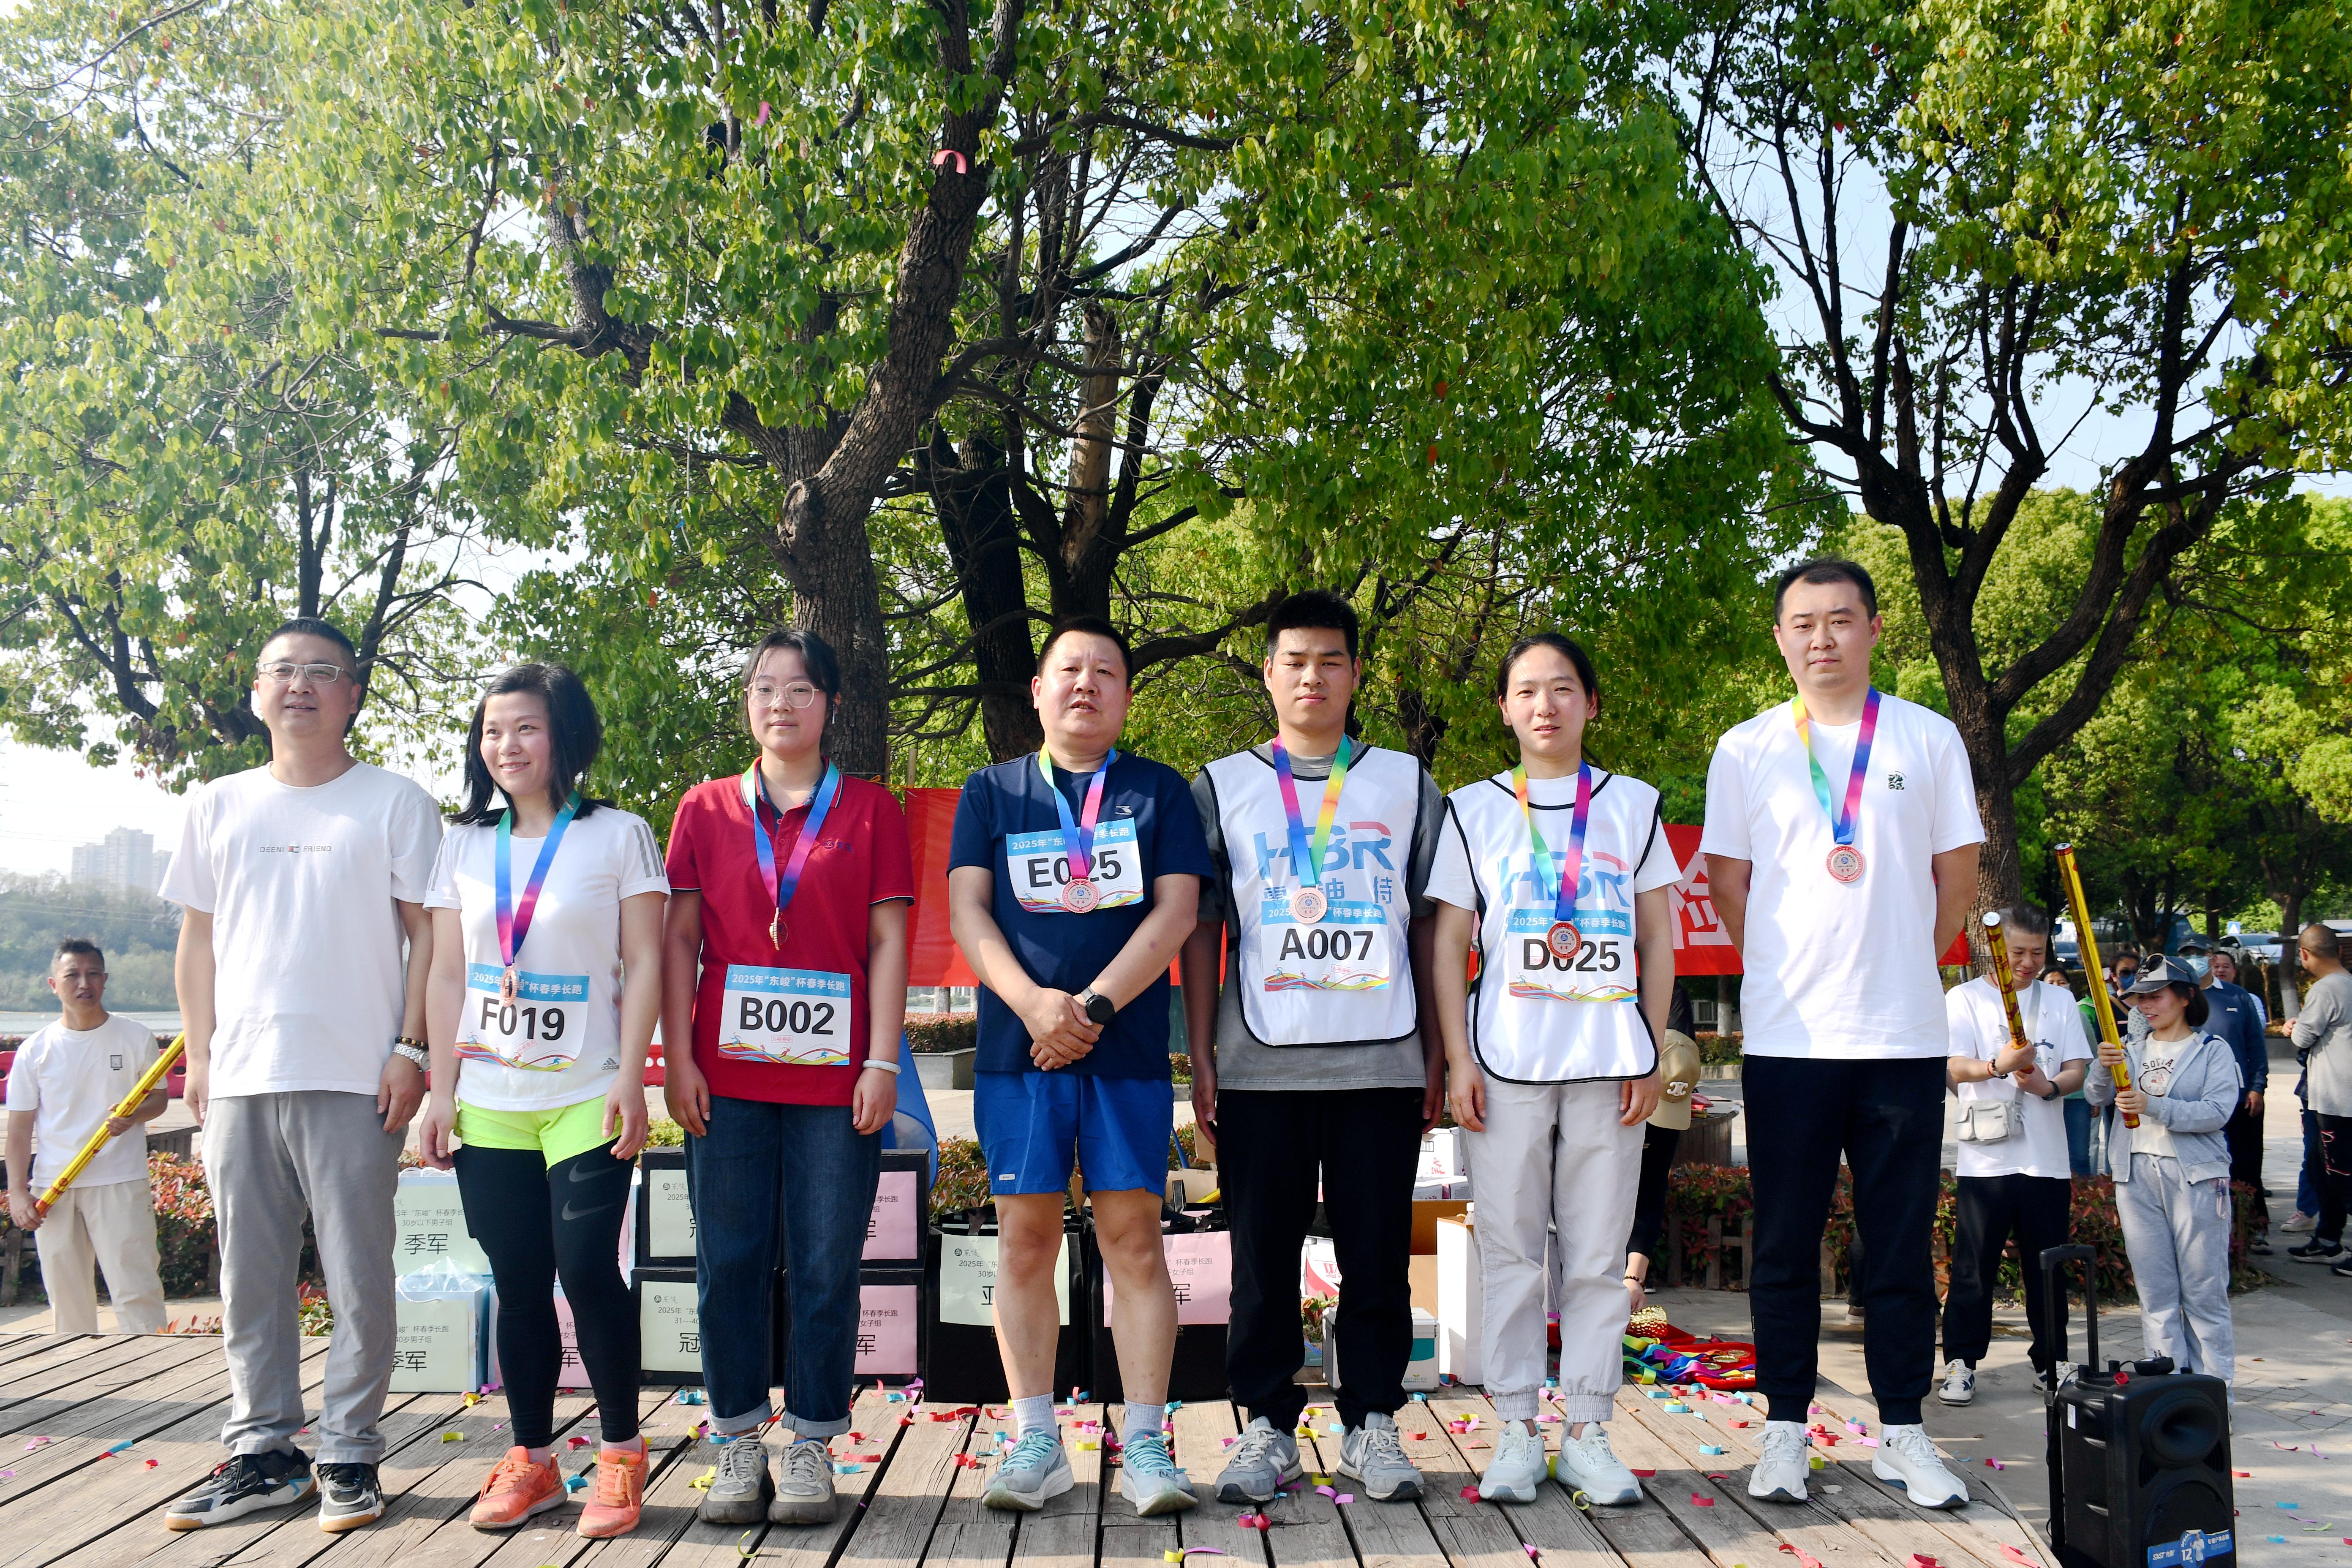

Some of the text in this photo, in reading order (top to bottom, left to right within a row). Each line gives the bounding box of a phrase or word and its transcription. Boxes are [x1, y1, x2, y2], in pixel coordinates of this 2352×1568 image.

[1253, 821, 1395, 880] HBR
[1279, 928, 1373, 961] A007
[731, 974, 846, 991] 2025年“东峻”杯春季长跑
[480, 996, 565, 1041] F019
[740, 996, 835, 1035] B002
[402, 1219, 453, 1227] 30岁以下男子组
[404, 1233, 448, 1255] 季军
[1173, 1283, 1192, 1305] 军
[679, 1333, 700, 1353] 冠
[856, 1334, 876, 1356] 军
[561, 1346, 579, 1368] 军
[2181, 1548, 2193, 1562] 12
